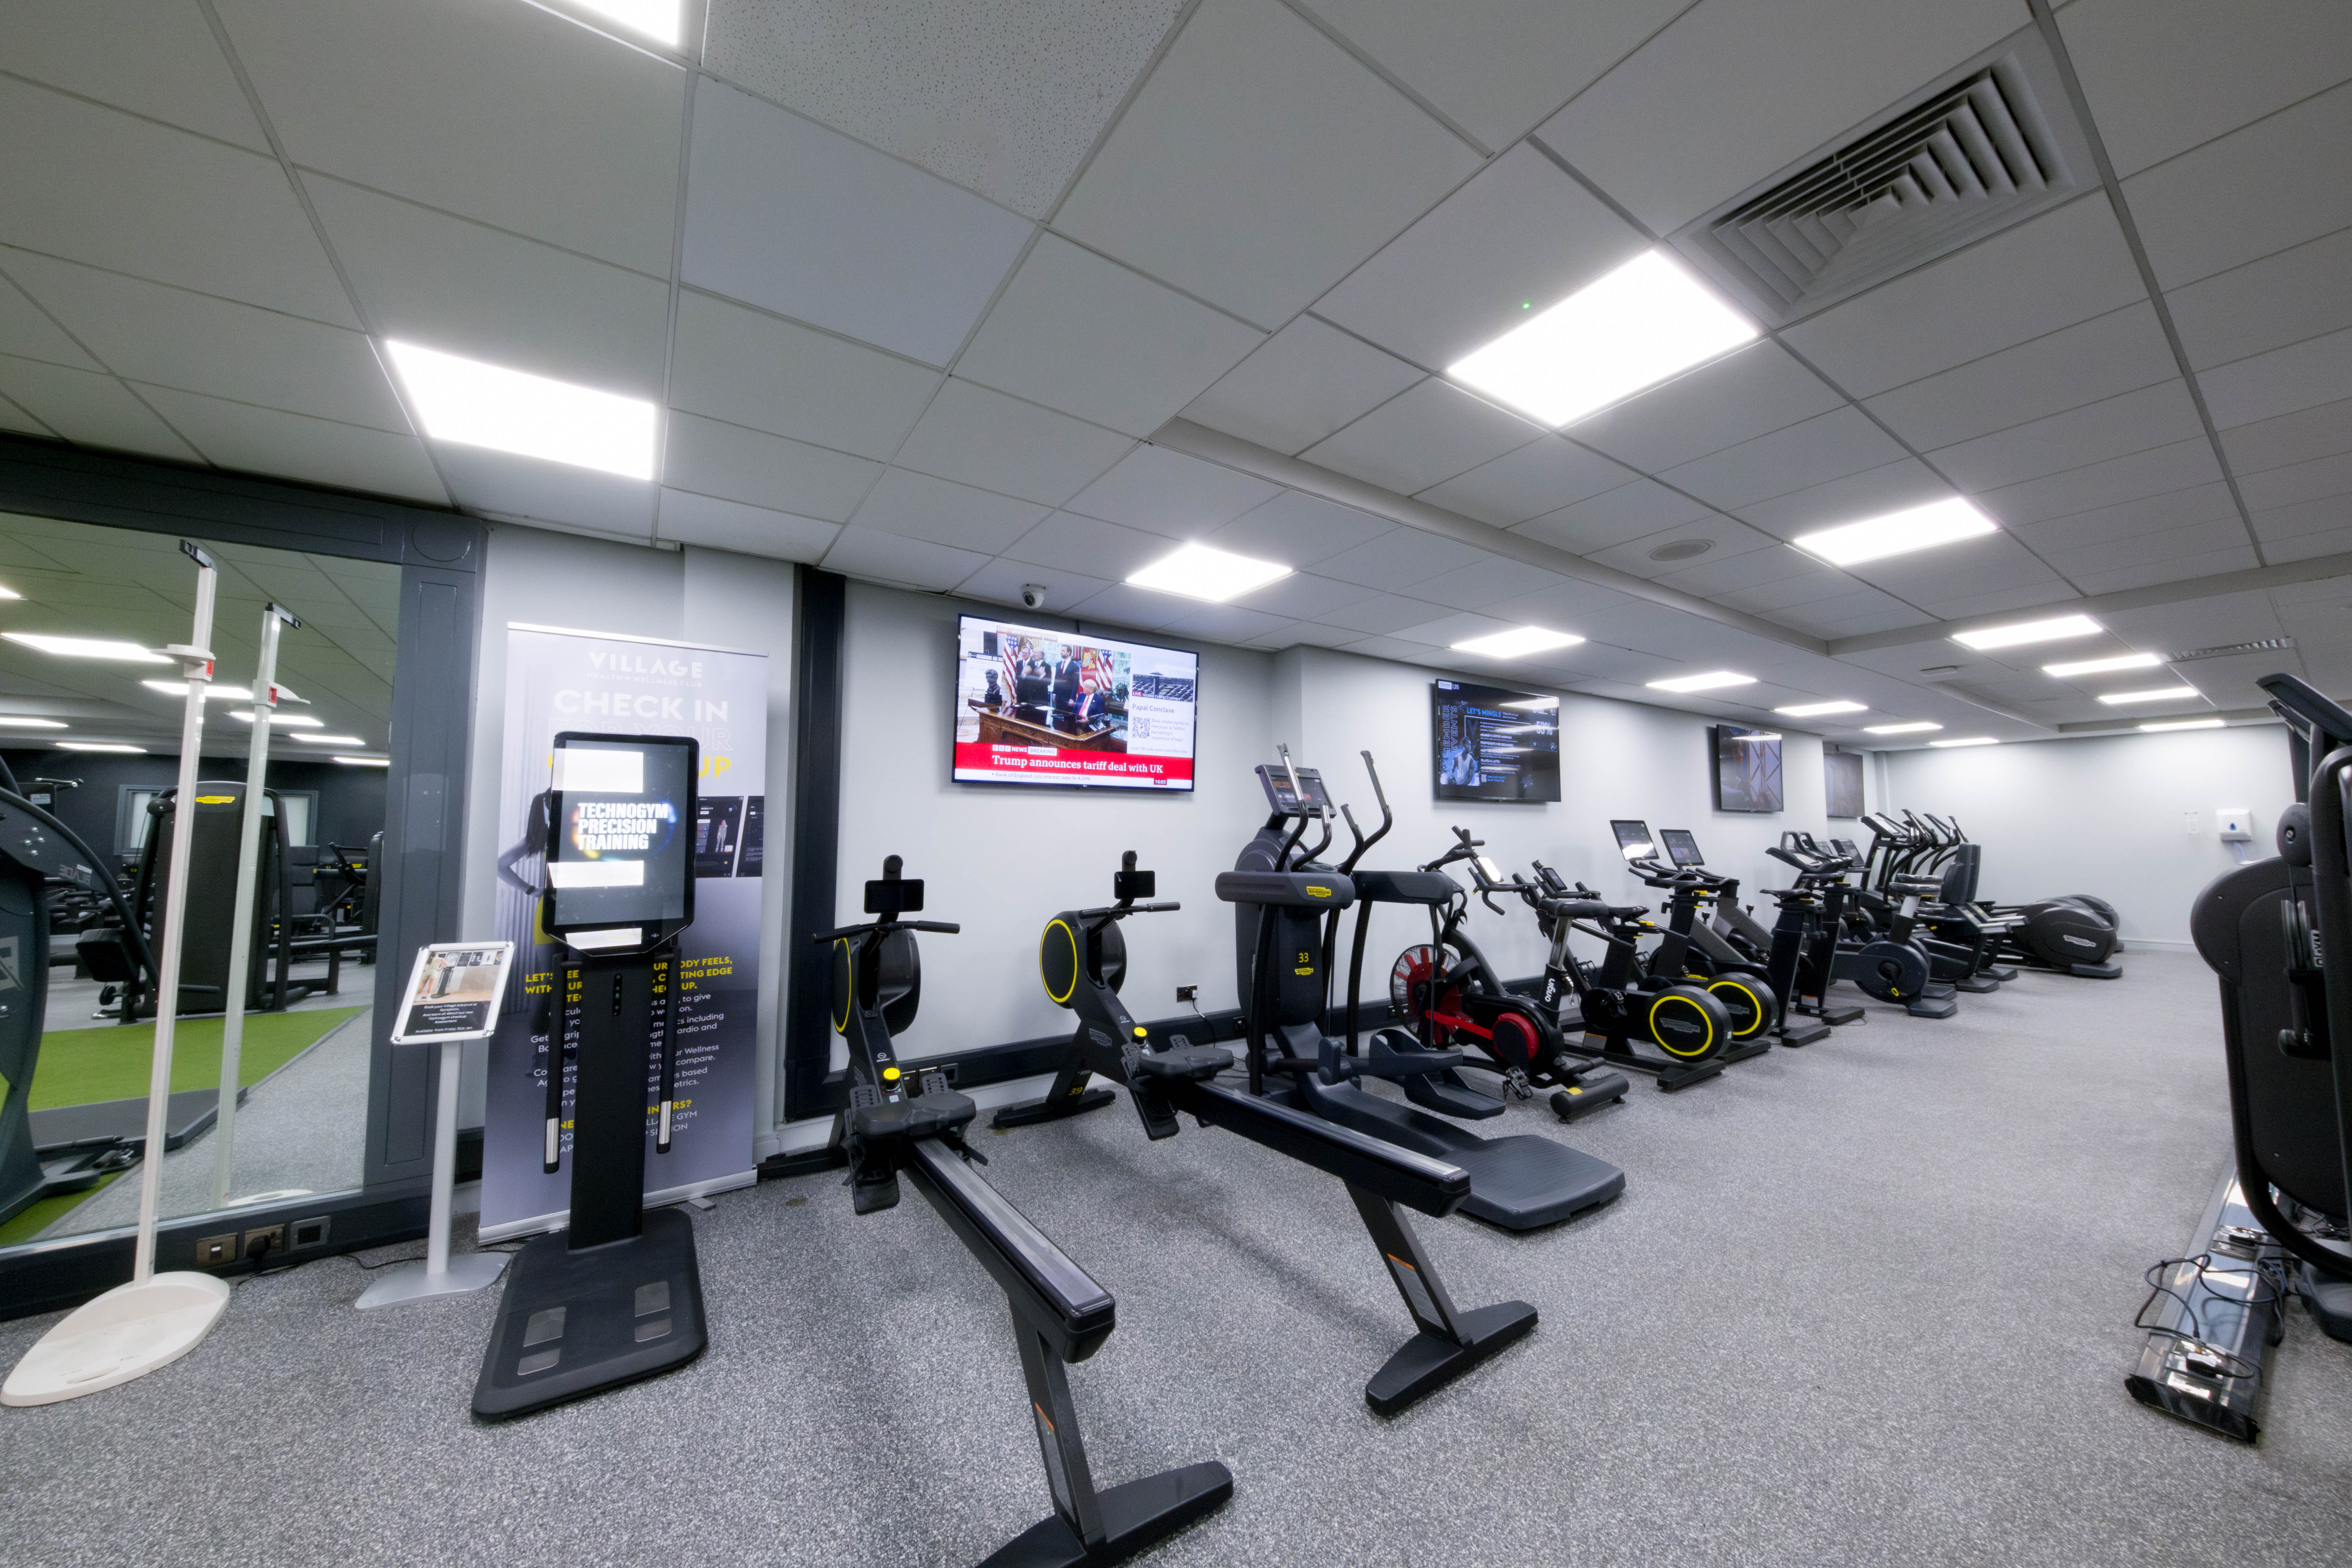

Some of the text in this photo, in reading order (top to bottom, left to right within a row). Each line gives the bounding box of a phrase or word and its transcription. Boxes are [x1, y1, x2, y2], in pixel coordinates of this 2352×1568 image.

[589, 651, 703, 678] VILLAGE
[587, 672, 622, 681] HEALTH
[633, 676, 678, 685] WELLNESS
[554, 689, 727, 722] CHECK IN
[1466, 707, 1481, 715] LET'S
[1482, 709, 1502, 718] MINGLE
[1442, 704, 1451, 758] MEMBER
[992, 755, 1163, 773] Trump announces tariff deal with UK
[578, 803, 668, 818] TECHNOGYM
[578, 819, 657, 834] PRECISION
[577, 834, 649, 850] TRAINING
[1308, 887, 1331, 897] TECHNOGYM
[1298, 952, 1309, 963] 33
[567, 970, 579, 978] EE
[680, 959, 700, 968] ODY
[702, 957, 732, 966] FEELS,
[707, 967, 732, 976] EDGE
[1545, 978, 1556, 1002] origin
[694, 994, 711, 1002] give
[687, 1014, 724, 1024] including
[677, 1023, 717, 1034] ardio and
[684, 1044, 719, 1054] Wellness
[676, 1055, 715, 1066] compare.
[682, 1067, 707, 1077] based
[1069, 1087, 1083, 1095] 39
[677, 1111, 697, 1120] GYM
